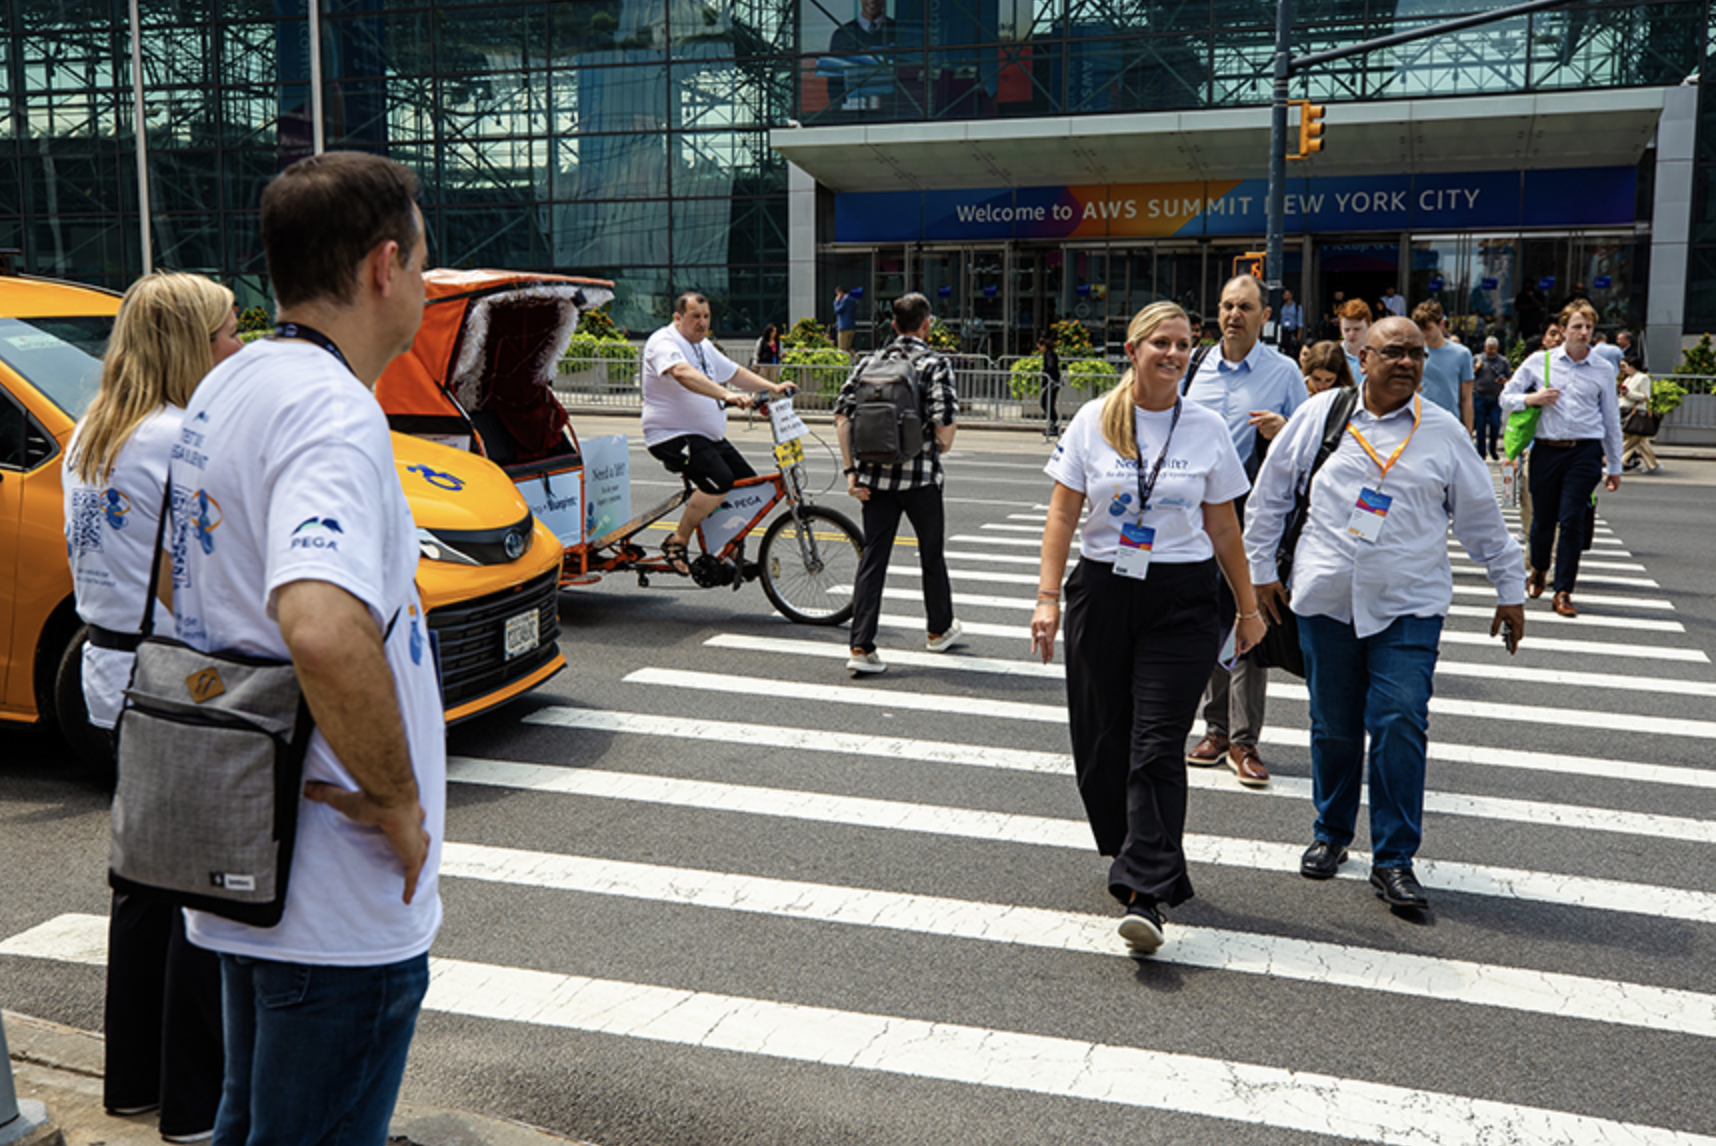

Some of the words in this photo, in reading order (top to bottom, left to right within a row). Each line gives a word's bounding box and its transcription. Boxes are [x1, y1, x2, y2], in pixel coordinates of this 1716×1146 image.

[956, 203, 1045, 223] Welcome
[1052, 205, 1073, 221] to
[1082, 199, 1138, 220] AWS
[1147, 196, 1252, 219] SUMMIT
[1335, 191, 1407, 213] YORK
[1419, 188, 1481, 211] CITY
[733, 495, 763, 510] PEGA
[291, 536, 338, 551] PEGA
